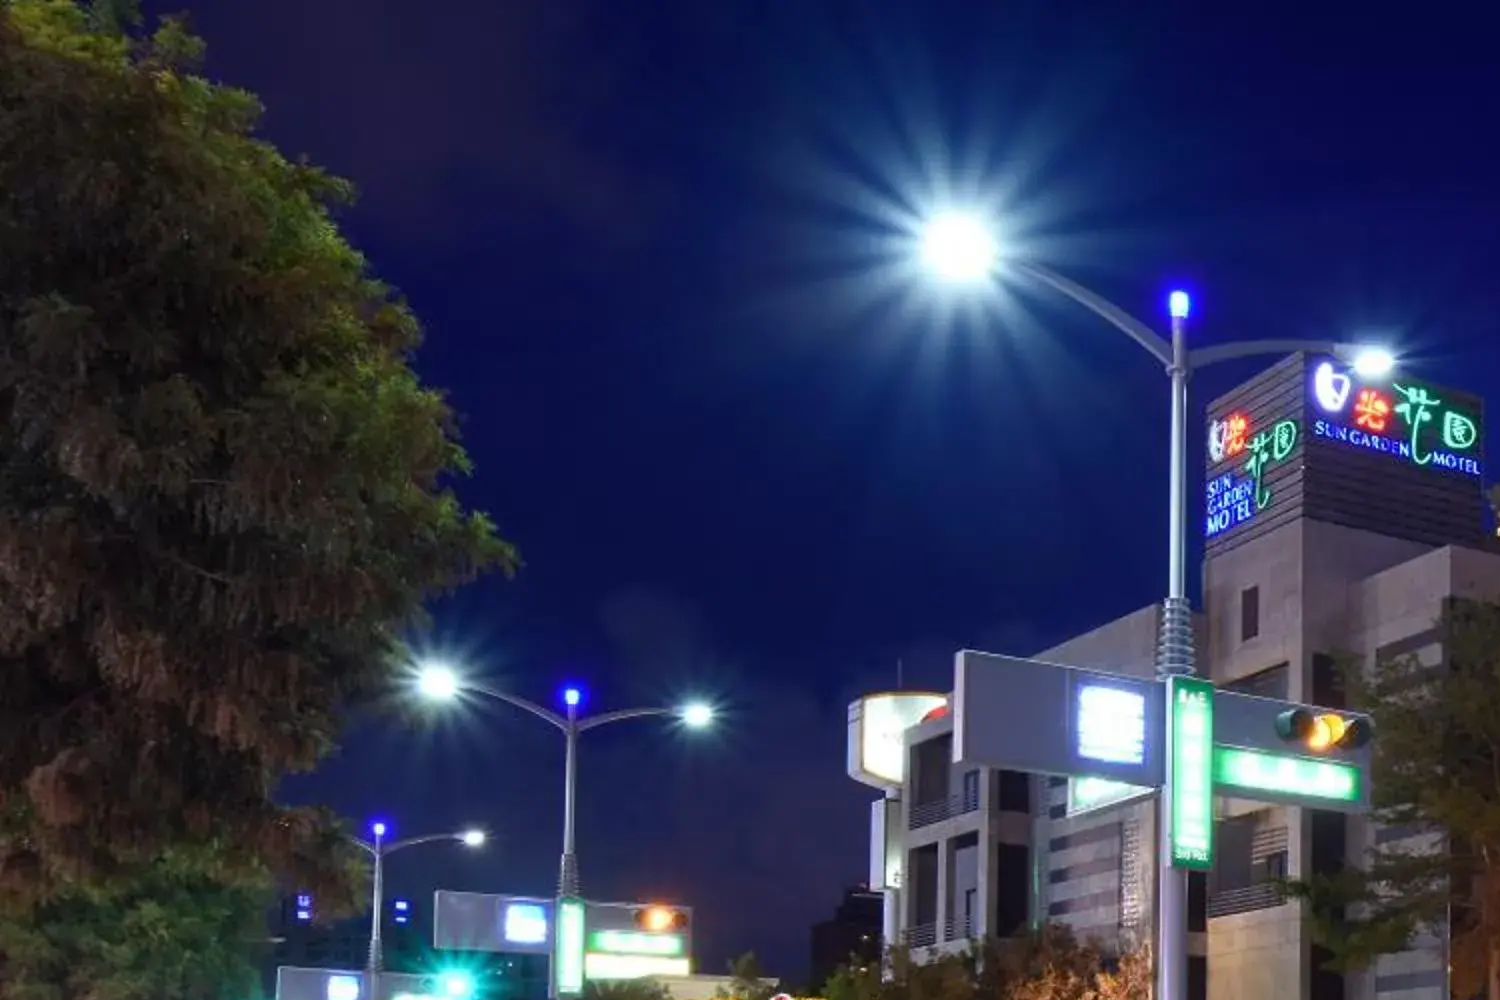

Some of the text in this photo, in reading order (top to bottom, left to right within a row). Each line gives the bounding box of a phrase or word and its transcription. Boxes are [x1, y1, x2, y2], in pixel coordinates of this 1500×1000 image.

[1432, 450, 1481, 475] MOTEL
[1207, 472, 1232, 499] SUN
[1207, 479, 1253, 515] GARDEN
[1206, 500, 1251, 534] MOTEL
